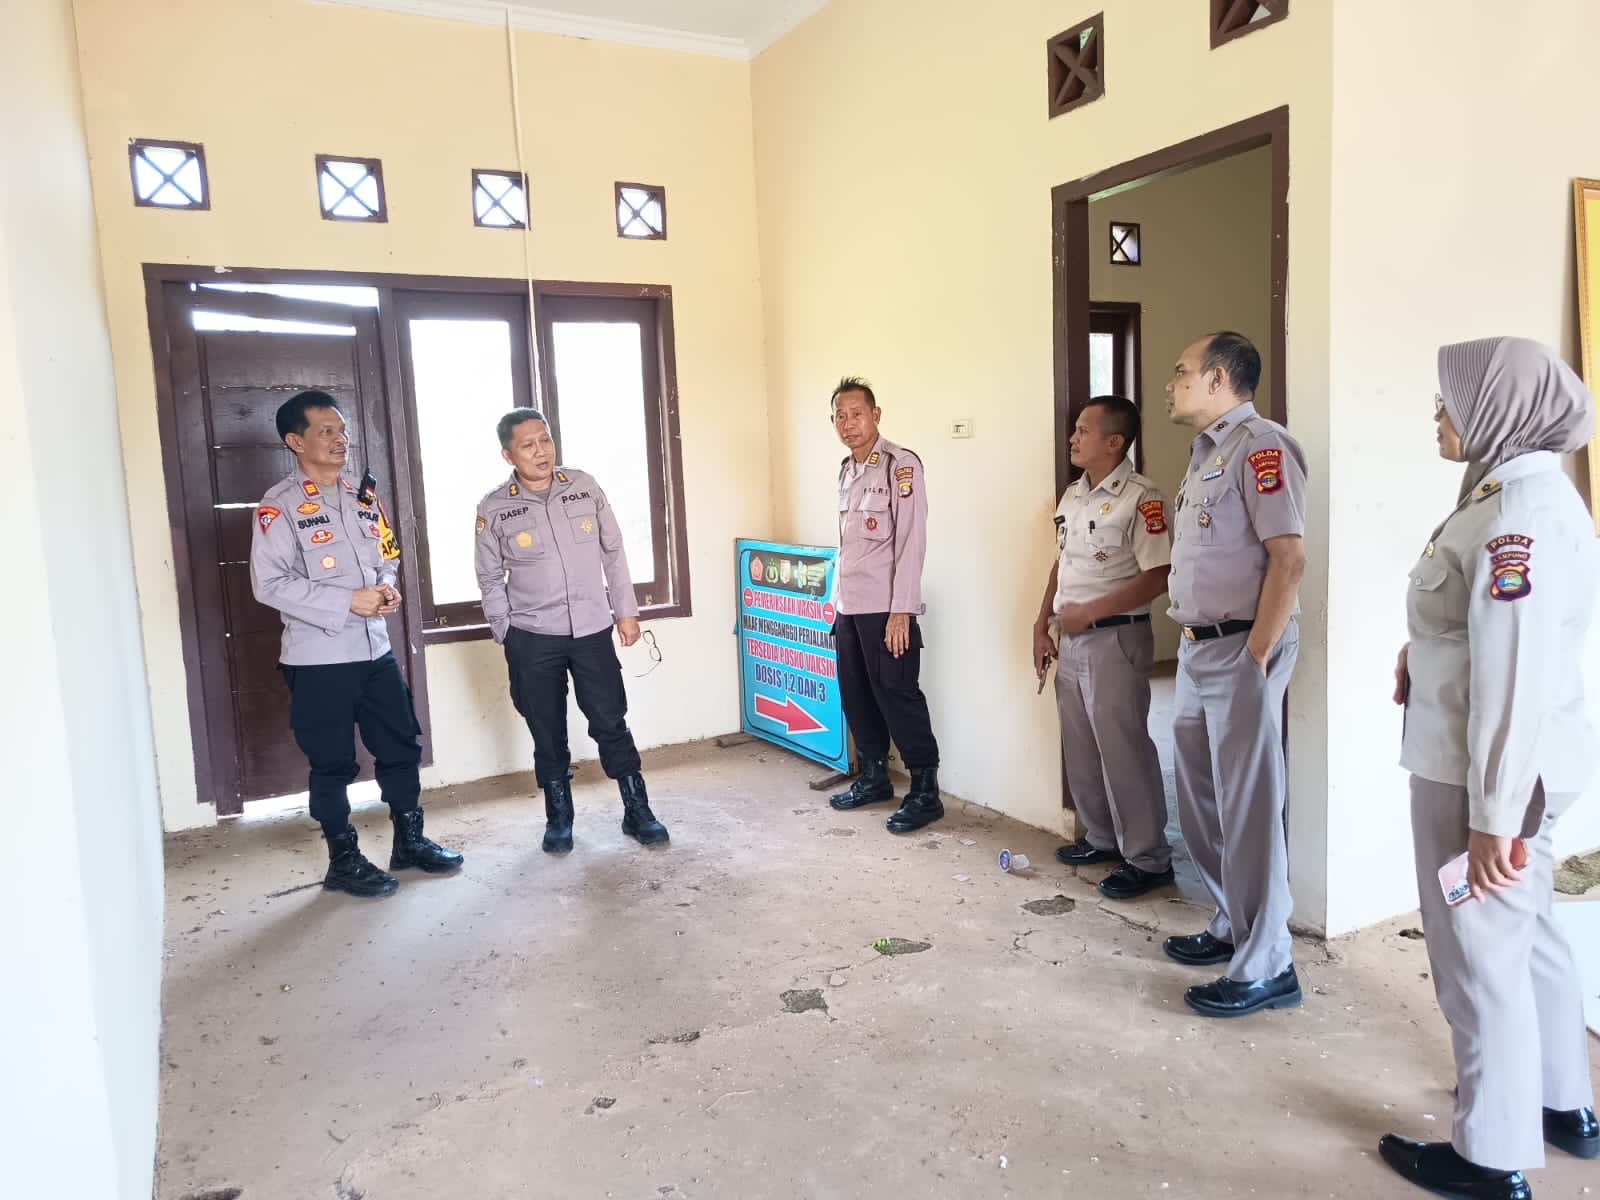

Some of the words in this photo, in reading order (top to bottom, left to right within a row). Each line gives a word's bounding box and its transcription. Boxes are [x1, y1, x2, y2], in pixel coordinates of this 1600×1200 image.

[1250, 450, 1279, 463] POLDA
[561, 491, 591, 504] POLRI
[499, 506, 529, 521] DASEP
[1490, 535, 1529, 550] POLDA
[753, 590, 796, 615] PEMERIKSAAN
[797, 599, 822, 620] VAKSIN
[743, 614, 758, 631] MAAF
[758, 615, 798, 642] MENGGANGGU
[746, 637, 779, 662] TERSEDIA
[780, 647, 805, 670] POSKO
[805, 653, 835, 678] VAKSIN
[755, 663, 782, 688] DOSIS
[797, 675, 817, 700] DAN
[818, 682, 826, 703] 3
